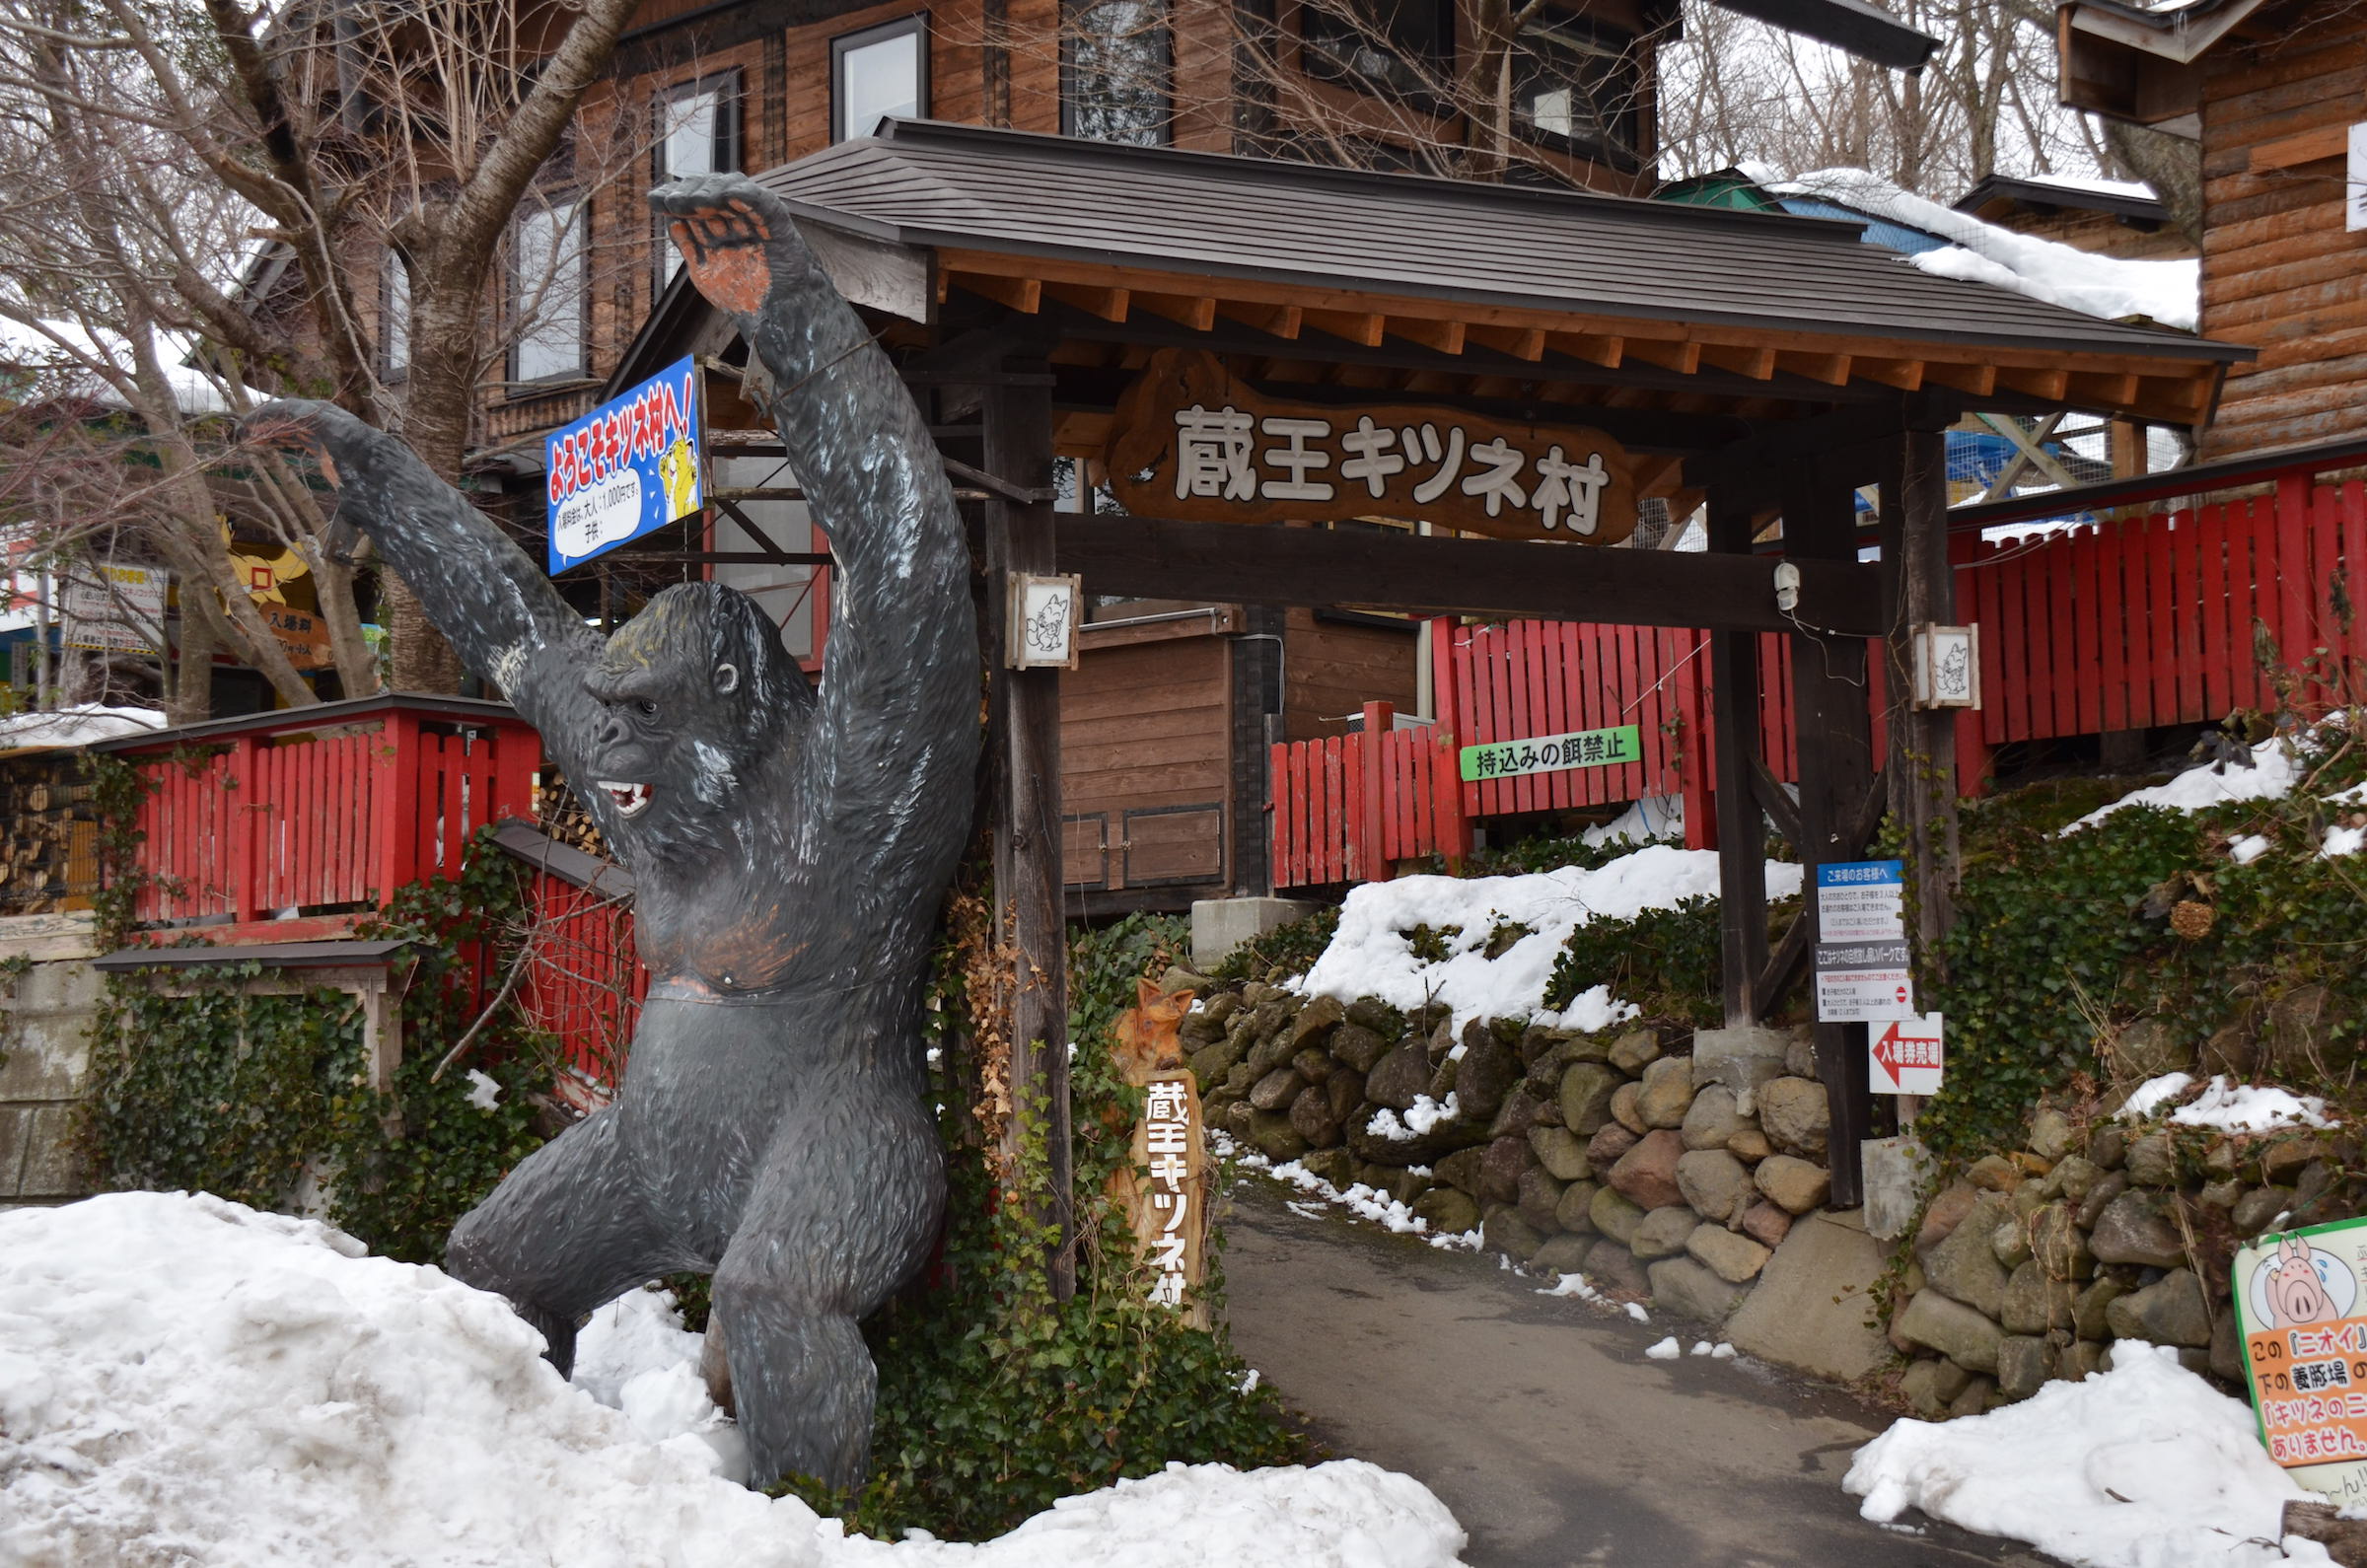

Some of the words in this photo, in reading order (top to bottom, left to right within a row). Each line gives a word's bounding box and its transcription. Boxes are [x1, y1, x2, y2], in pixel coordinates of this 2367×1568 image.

[1174, 404, 1610, 536] 蔵王キツネ村
[1476, 732, 1626, 777] 持込みの餌禁止
[1827, 867, 1889, 883] ご来場のお客様へ
[1881, 1040, 1939, 1065] 入場券売場
[1146, 1081, 1190, 1310] 蔵王キツネ村
[2271, 1428, 2367, 1460] ありません。
